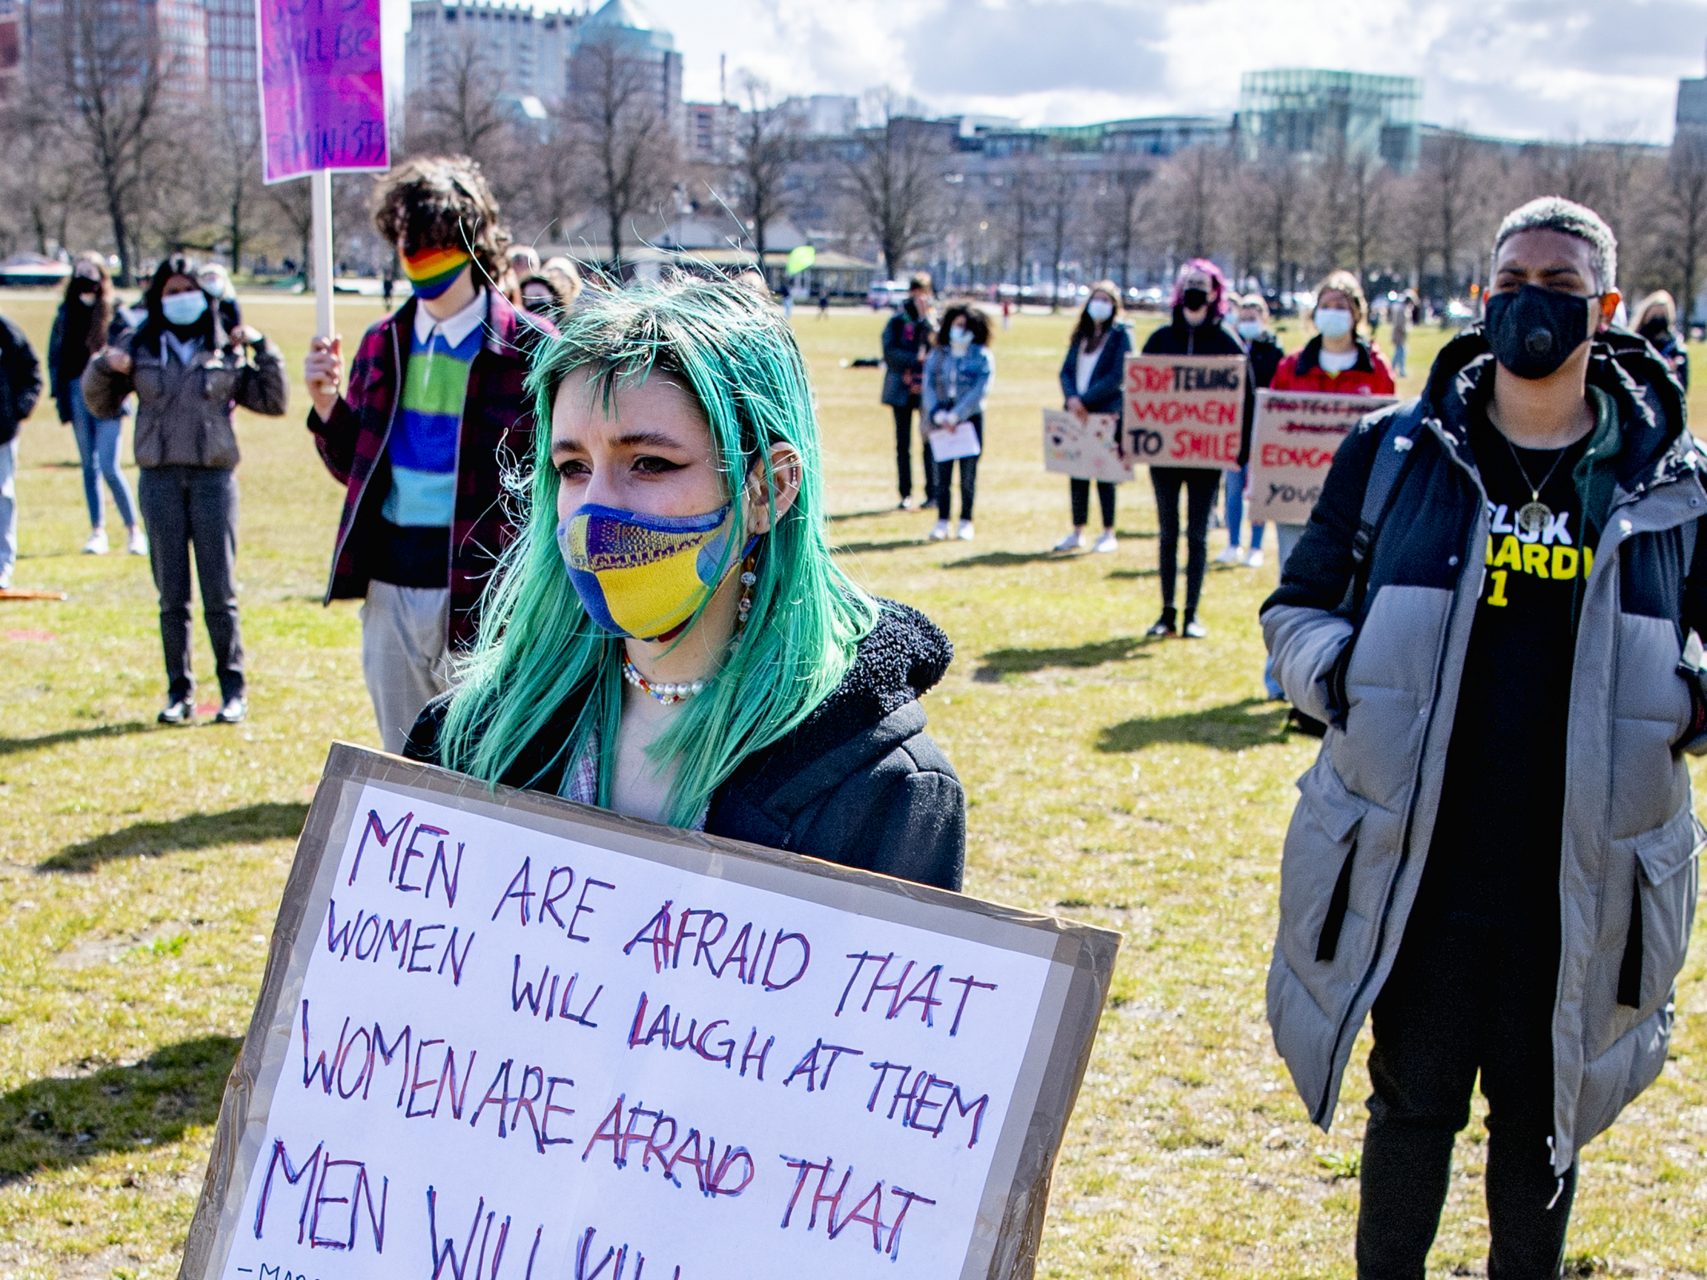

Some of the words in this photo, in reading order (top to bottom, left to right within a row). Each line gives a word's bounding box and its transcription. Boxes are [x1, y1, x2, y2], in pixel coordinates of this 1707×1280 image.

[1128, 363, 1174, 393] STOP
[1131, 400, 1236, 425] WOMEN
[1127, 429, 1163, 455] TO
[1170, 430, 1240, 462] SMILE
[348, 809, 465, 909] MEN
[491, 856, 616, 943] ARE
[623, 900, 811, 992] AFRAID
[845, 950, 999, 1037] THAT
[327, 898, 476, 987] WOMEN
[511, 954, 605, 1028] WILL
[627, 991, 776, 1081] LAUGH
[783, 1037, 864, 1092] AT
[866, 1061, 990, 1149] THEM
[302, 999, 478, 1120] WOMEN
[469, 1058, 576, 1155] ARE
[582, 1093, 755, 1199] AFRAID
[779, 1154, 937, 1262] THAT
[253, 1136, 390, 1255] MEN
